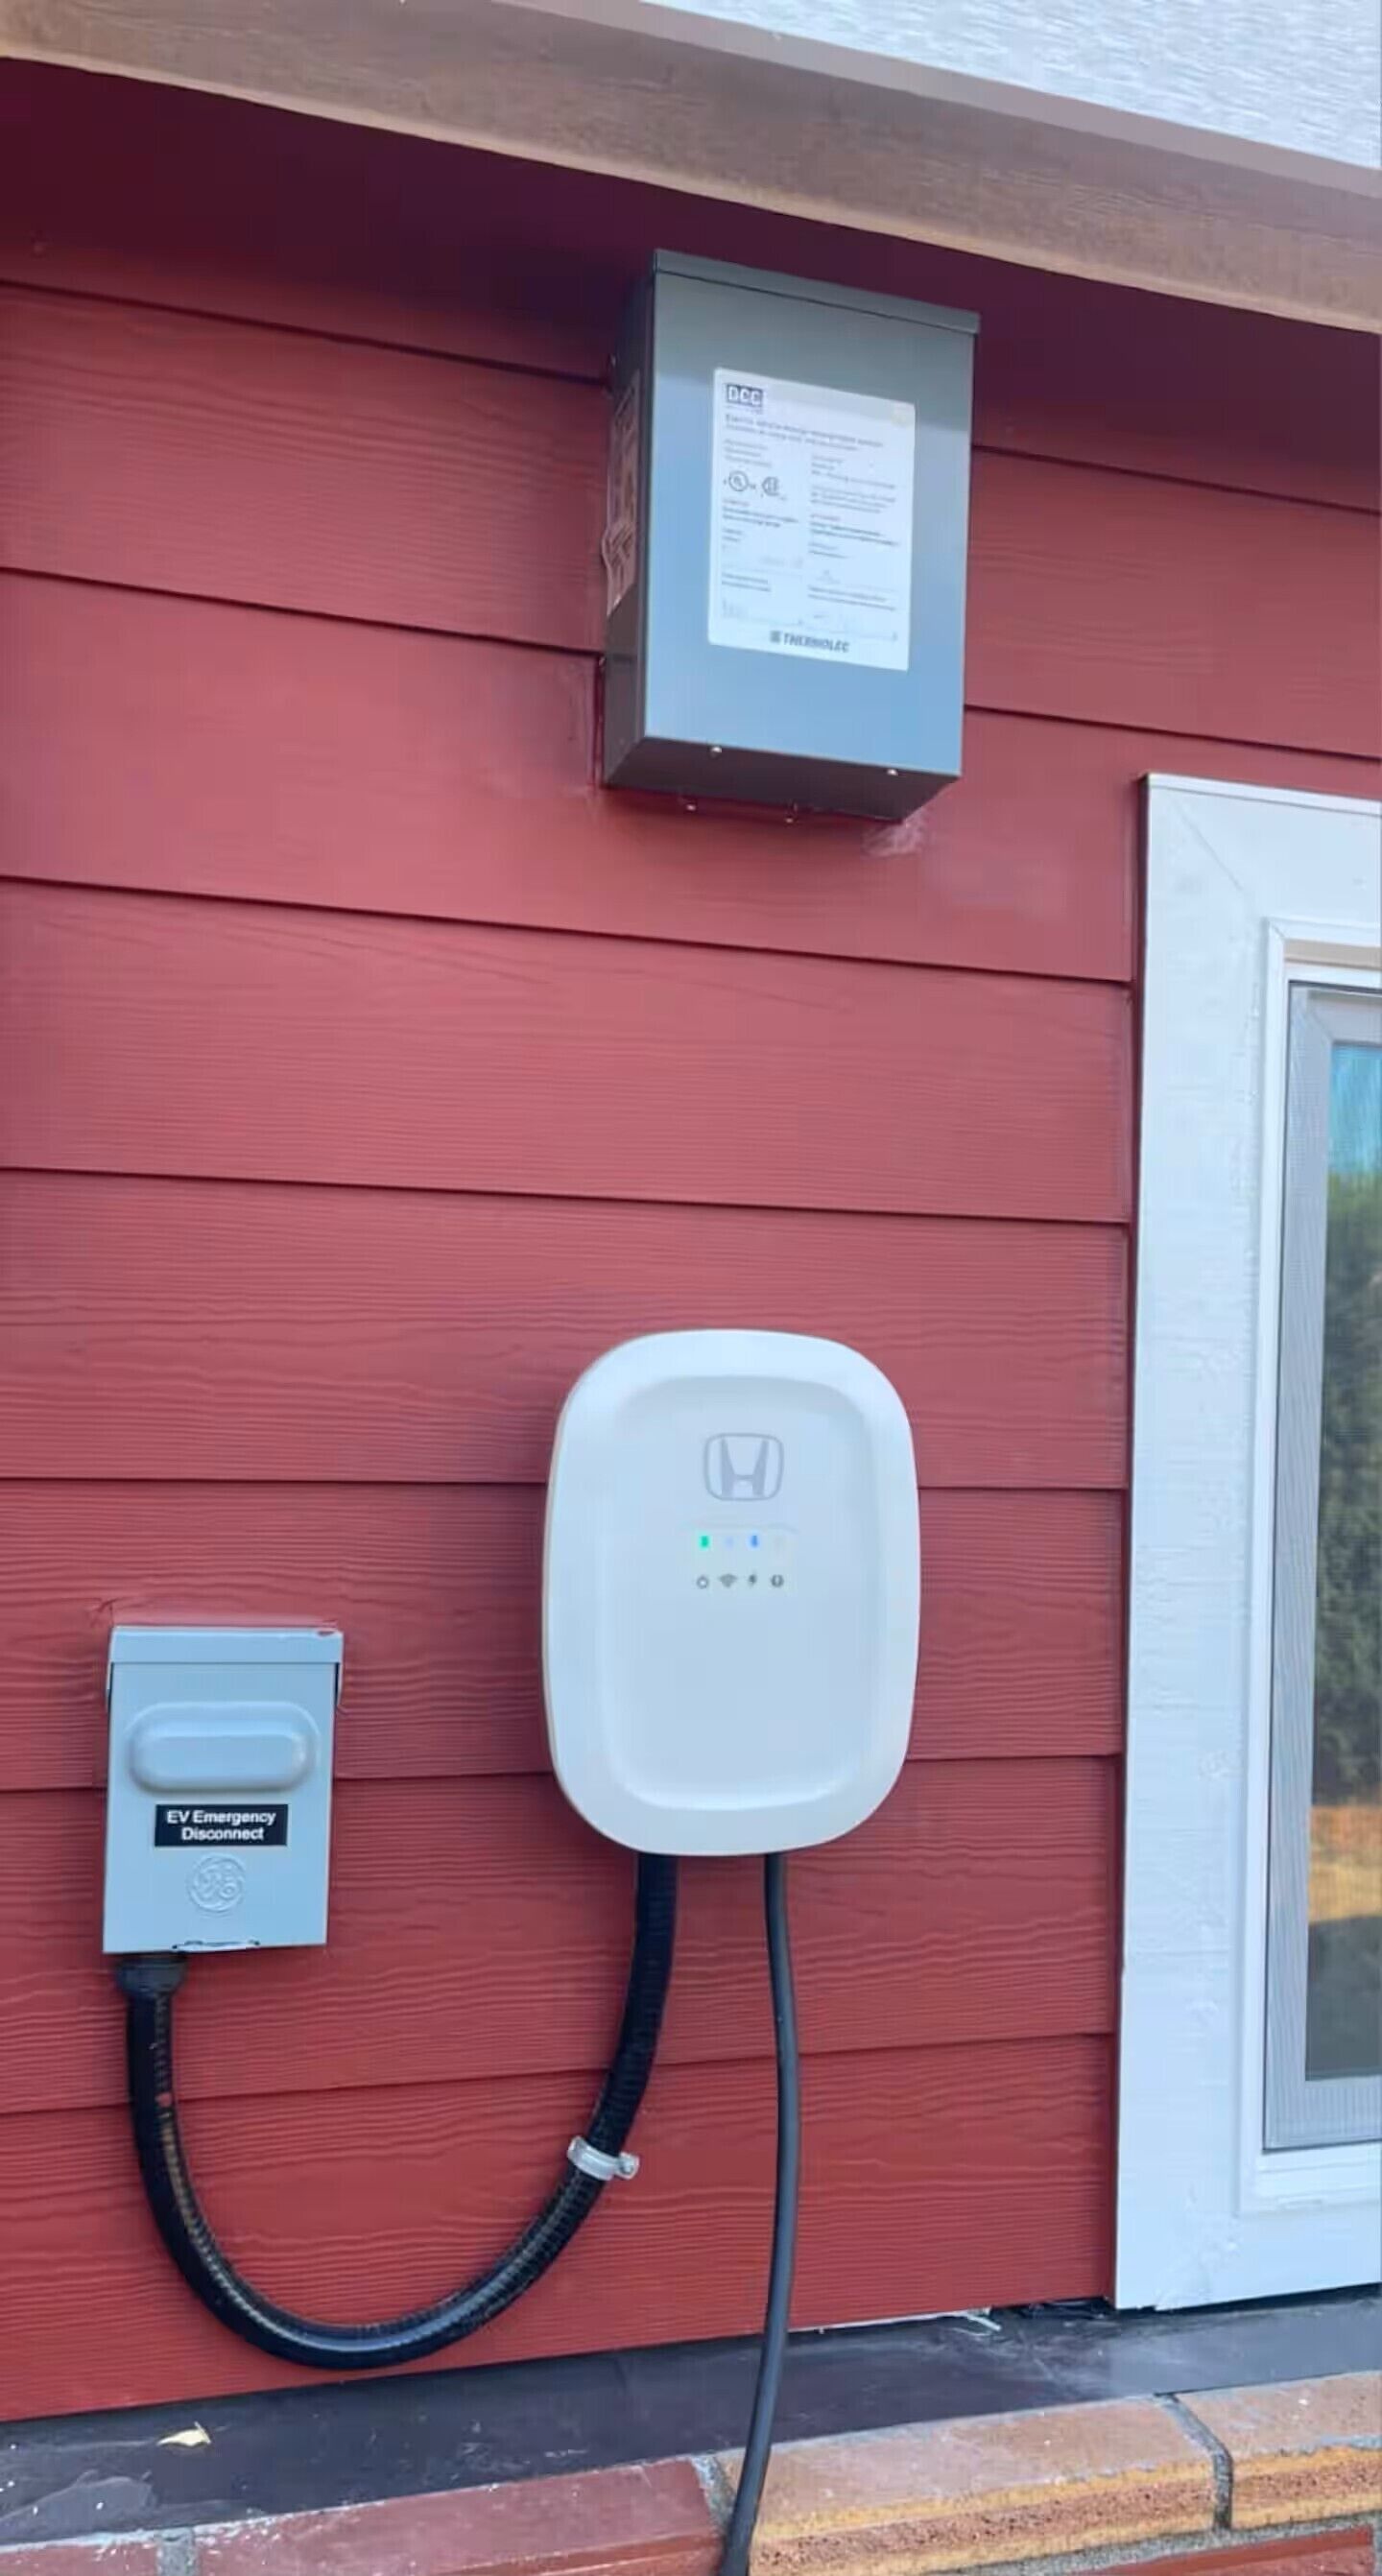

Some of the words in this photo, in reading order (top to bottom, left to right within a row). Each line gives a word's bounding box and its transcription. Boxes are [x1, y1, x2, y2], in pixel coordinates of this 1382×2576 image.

[727, 385, 762, 406] DCC
[167, 1809, 190, 1824] EV
[193, 1809, 276, 1826] Emergency
[181, 1826, 265, 1841] Disconnect
